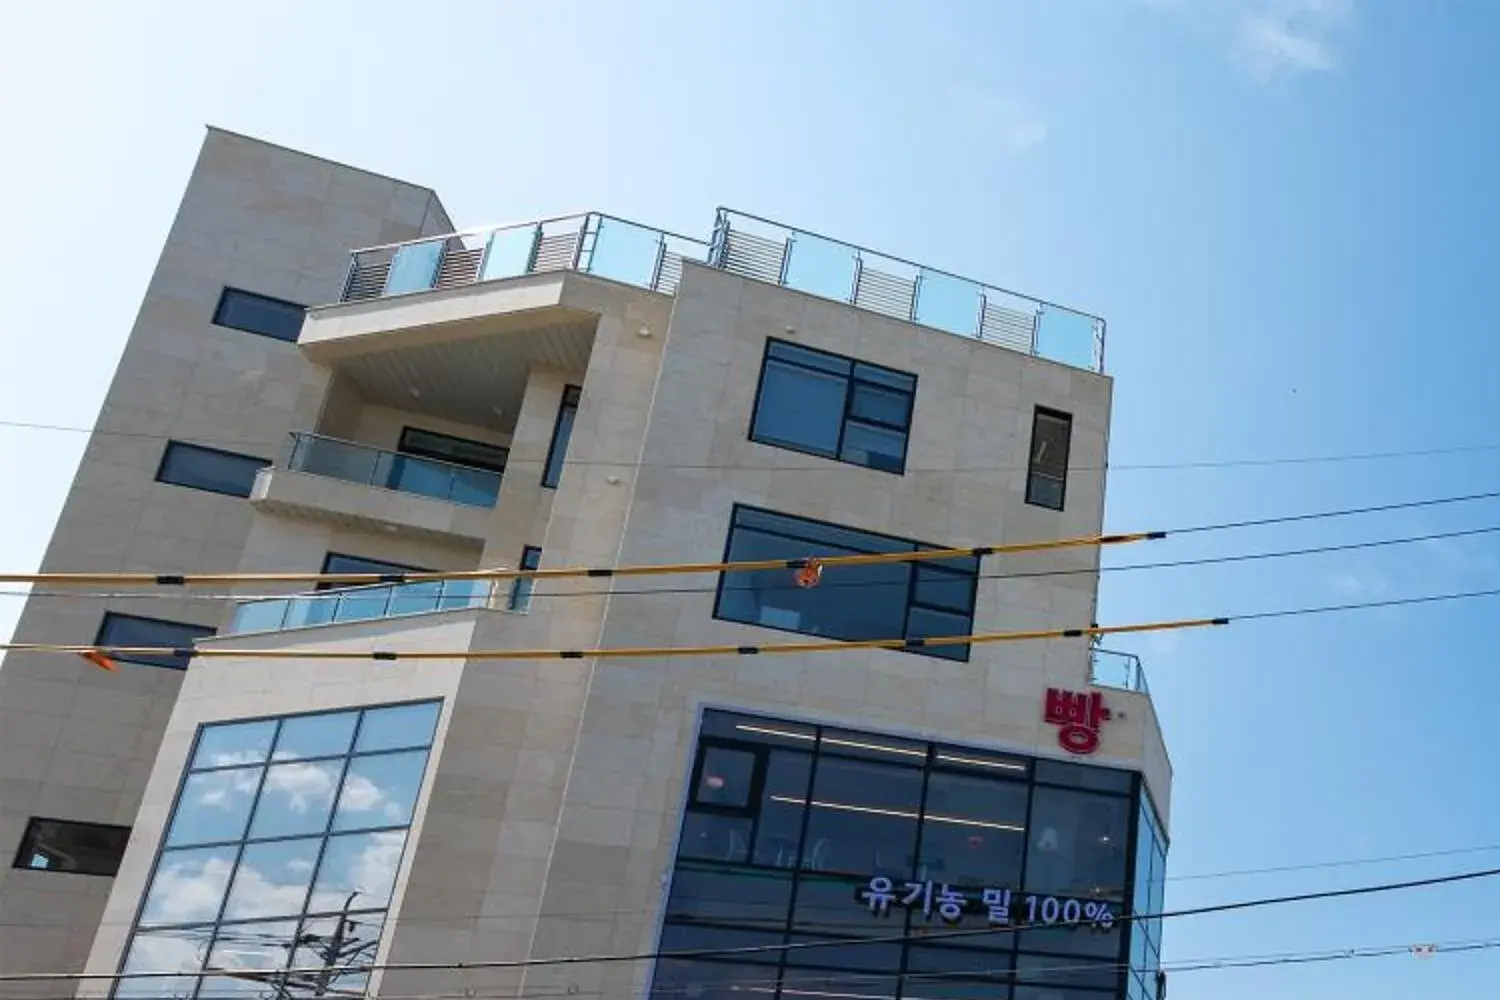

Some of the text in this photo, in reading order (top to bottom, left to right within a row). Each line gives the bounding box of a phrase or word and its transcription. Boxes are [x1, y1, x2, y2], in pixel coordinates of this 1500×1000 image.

[1044, 688, 1111, 755] 빵
[861, 876, 1115, 928] 유기농 밀 100%
